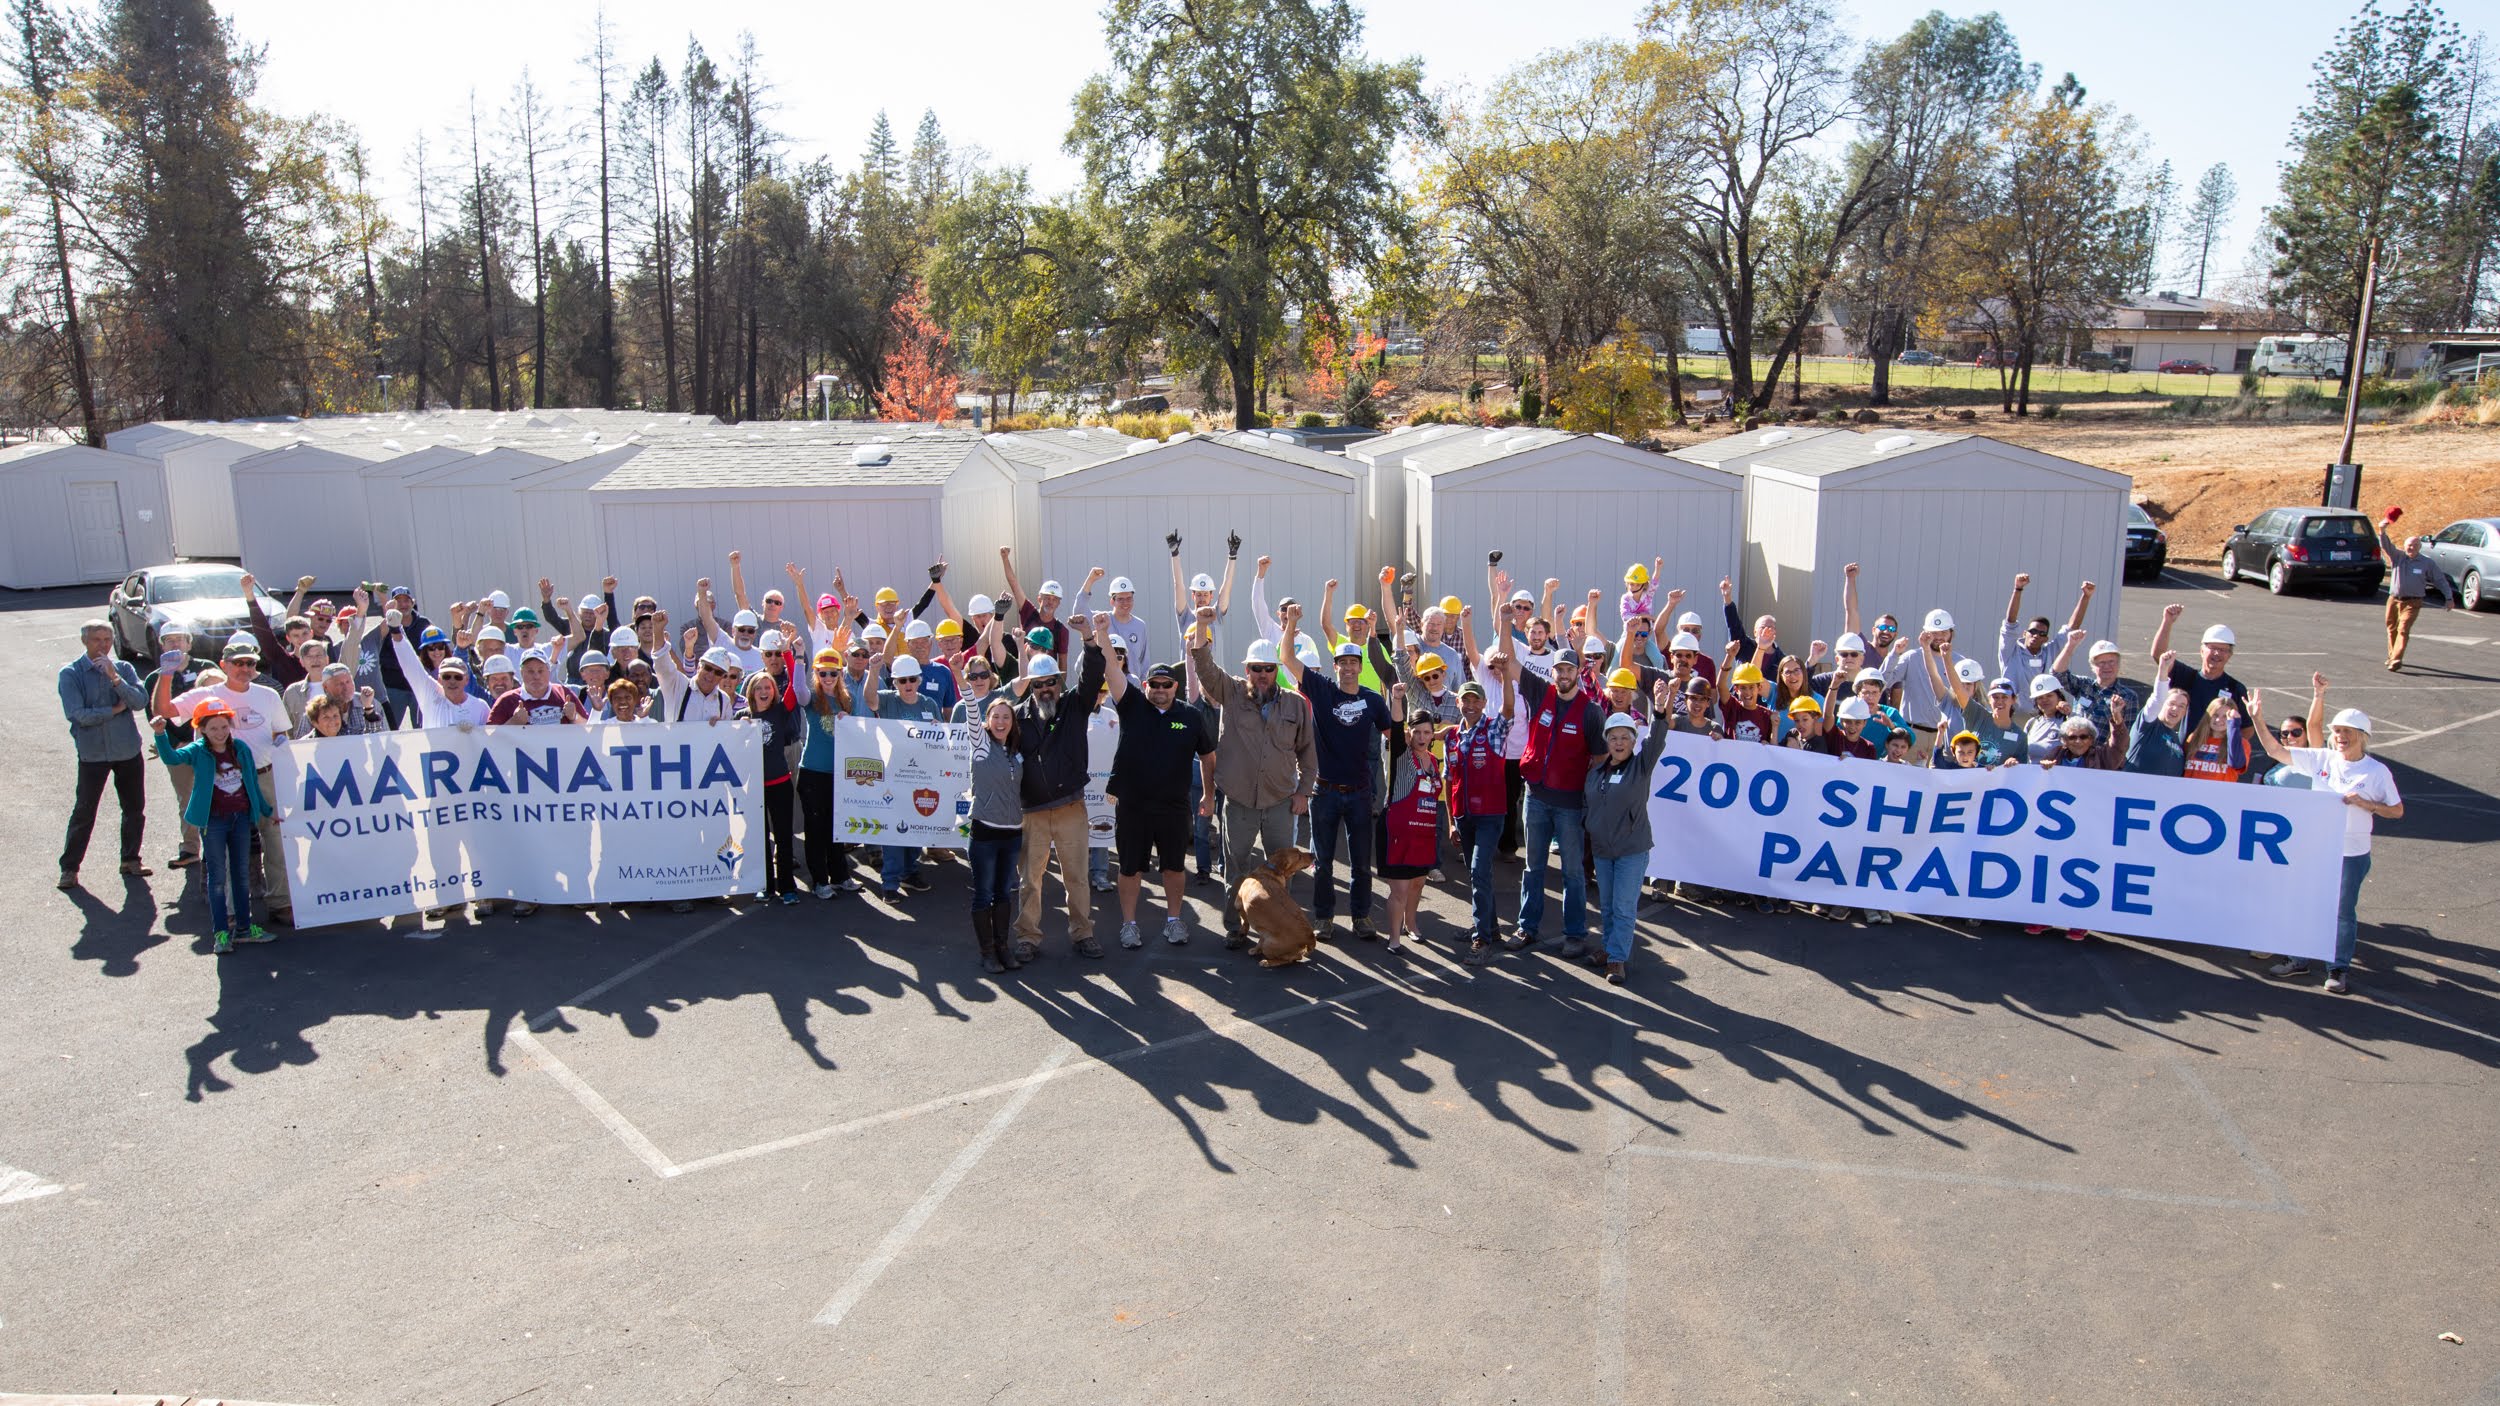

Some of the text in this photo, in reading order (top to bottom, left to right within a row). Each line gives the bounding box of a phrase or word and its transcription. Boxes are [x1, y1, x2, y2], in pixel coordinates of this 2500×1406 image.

[907, 727, 945, 741] Camp
[303, 743, 744, 811] MARANATHA
[851, 769, 880, 778] FARMS
[2185, 760, 2228, 774] ETROIT
[1084, 793, 1105, 802] otary
[1654, 755, 2293, 865] 200 SHEDS FOR
[306, 798, 744, 840] VOLUNTEERS INTERNATIONAL
[696, 875, 744, 883] INTERNATIOL
[1758, 831, 2156, 916] PARADISE
[316, 869, 482, 905] maranatha.org
